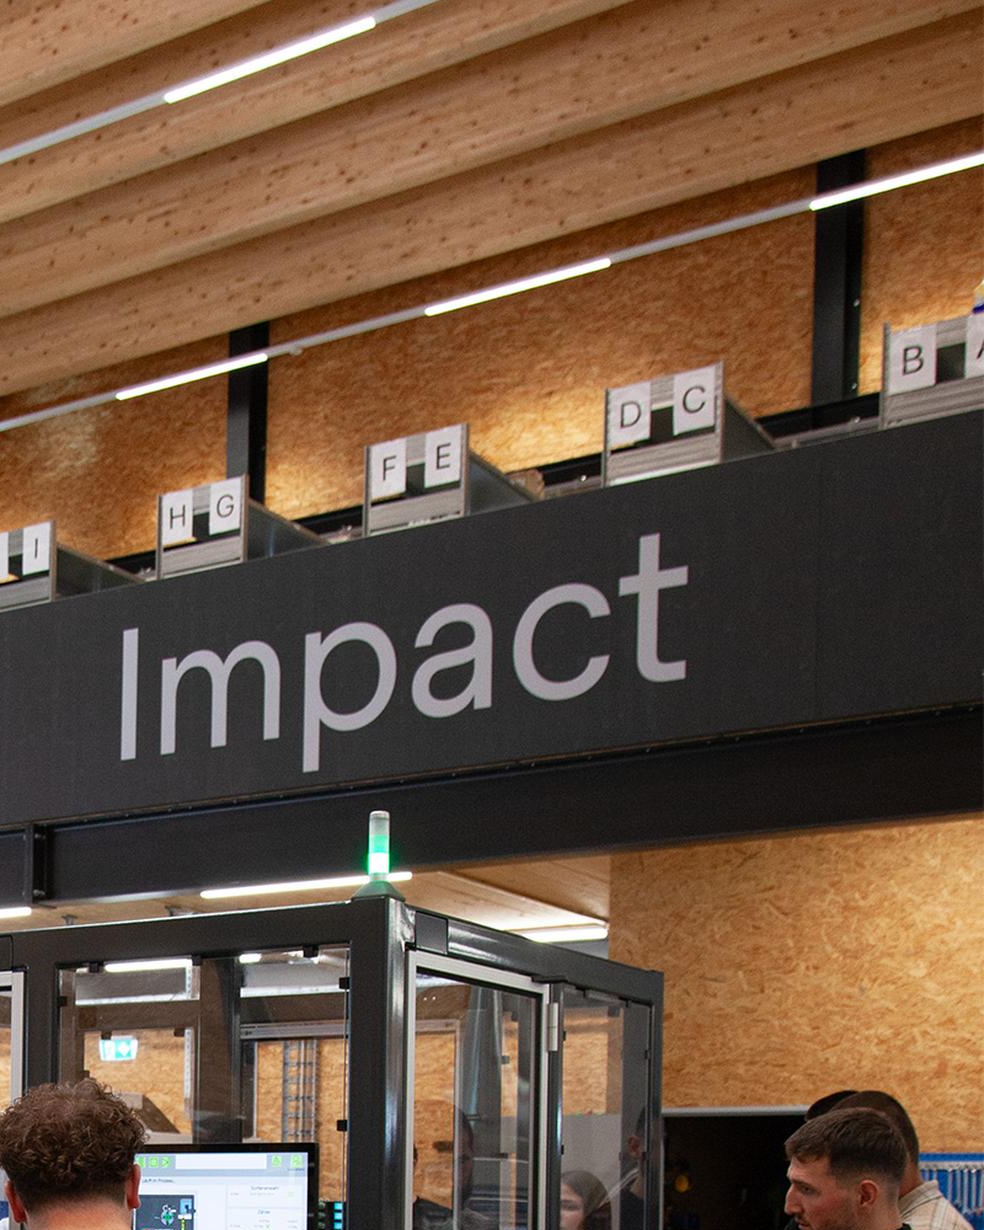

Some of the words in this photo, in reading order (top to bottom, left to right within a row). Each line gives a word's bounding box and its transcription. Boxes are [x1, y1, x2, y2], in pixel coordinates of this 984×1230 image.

[902, 345, 924, 376] B
[682, 386, 706, 415] C
[620, 401, 642, 430] D
[383, 454, 397, 482] F
[436, 442, 452, 471] E
[170, 504, 186, 530] H
[216, 493, 235, 519] G
[120, 533, 688, 773] Impact
